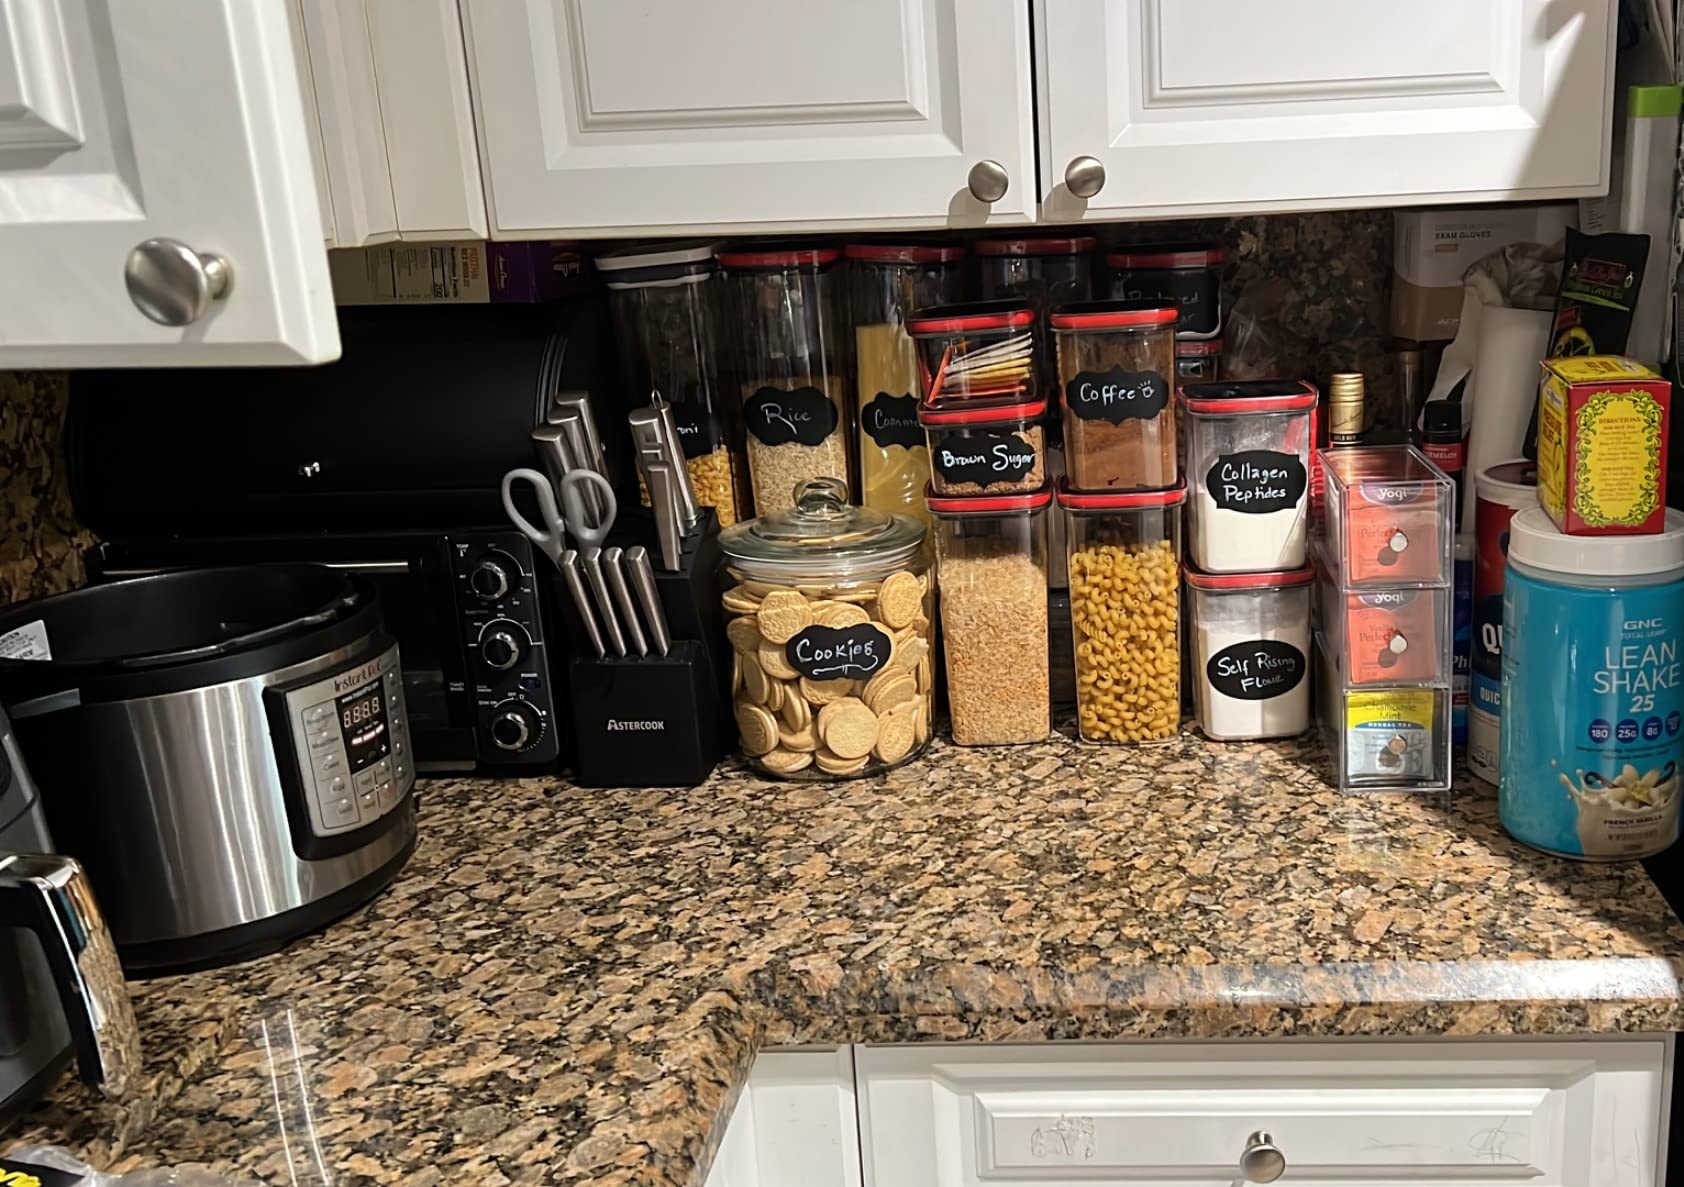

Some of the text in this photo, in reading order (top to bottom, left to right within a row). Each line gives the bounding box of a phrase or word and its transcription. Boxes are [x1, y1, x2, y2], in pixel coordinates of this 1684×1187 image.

[1080, 382, 1136, 406] Coffee
[760, 402, 813, 435] Rice
[1599, 416, 1641, 424] DIRECTIONS
[941, 444, 1036, 471] Brown Sugar
[1221, 462, 1288, 485] Collagen
[1223, 485, 1287, 504] Peptides
[1377, 488, 1408, 501] yogi
[1374, 592, 1405, 604] yogi
[1624, 618, 1664, 630] GNC
[796, 638, 875, 663] Cookies
[1605, 639, 1676, 670] LEAN
[1217, 652, 1296, 677] Self Rising
[1593, 663, 1681, 694] SHAKE
[1363, 700, 1417, 712] Chamomile
[1629, 694, 1656, 713] 25
[1367, 721, 1412, 729] HERBAL TEA
[1380, 711, 1402, 720] Mint
[1591, 729, 1608, 738] 180
[1636, 814, 1662, 823] VANILLA
